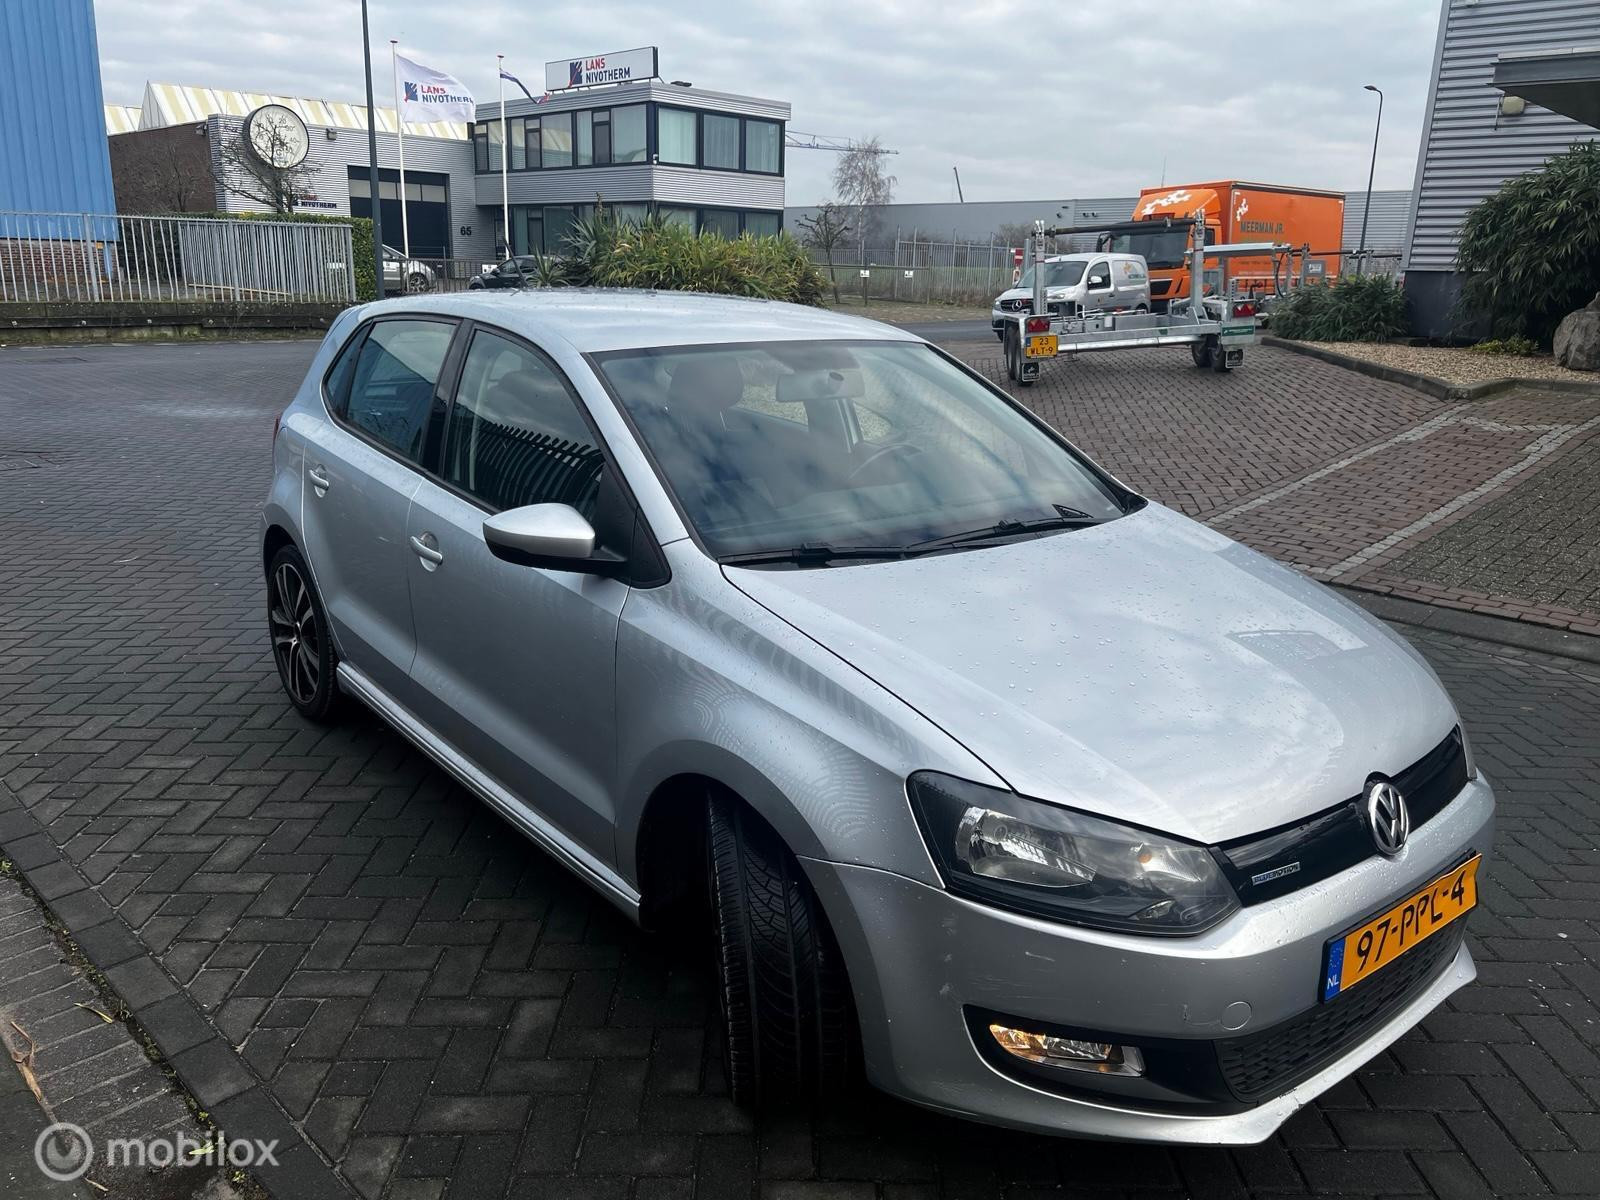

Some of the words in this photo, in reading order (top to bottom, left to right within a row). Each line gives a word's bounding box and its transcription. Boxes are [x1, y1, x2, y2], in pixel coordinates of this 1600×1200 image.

[585, 57, 606, 71] LANS
[585, 66, 631, 84] NIVOTHERM
[420, 84, 447, 94] LANS
[460, 226, 472, 236] 65
[1240, 220, 1274, 235] MEERMAN
[1039, 337, 1049, 346] 23
[1326, 975, 1340, 991] NL
[1356, 868, 1466, 973] 97-PPL-4
